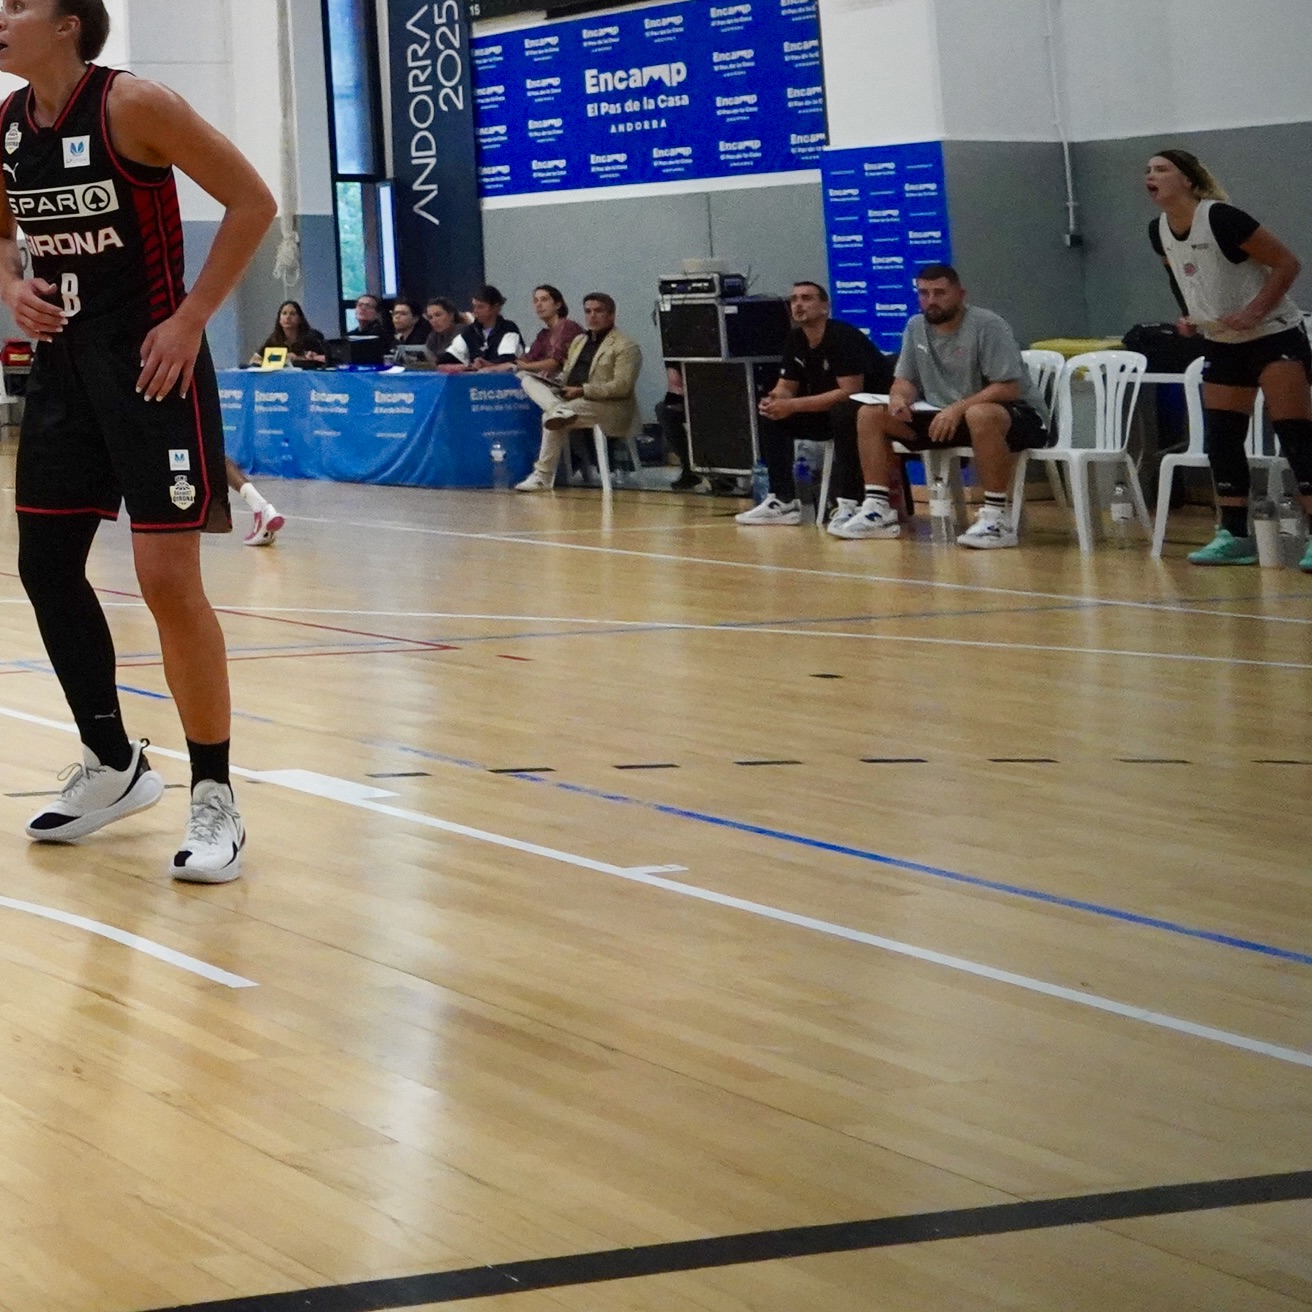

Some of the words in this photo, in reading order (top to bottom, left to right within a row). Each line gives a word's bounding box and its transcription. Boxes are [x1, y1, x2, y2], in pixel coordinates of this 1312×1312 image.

[433, 0, 464, 112] 2025
[584, 61, 688, 95] Encamp
[405, 4, 440, 226] ANDORRA
[586, 103, 598, 117] El
[600, 101, 622, 116] Pas
[623, 99, 641, 113] de
[643, 96, 655, 111] la
[657, 94, 690, 109] Casa
[610, 118, 667, 134] ANDORRA
[9, 193, 77, 215] SPAR
